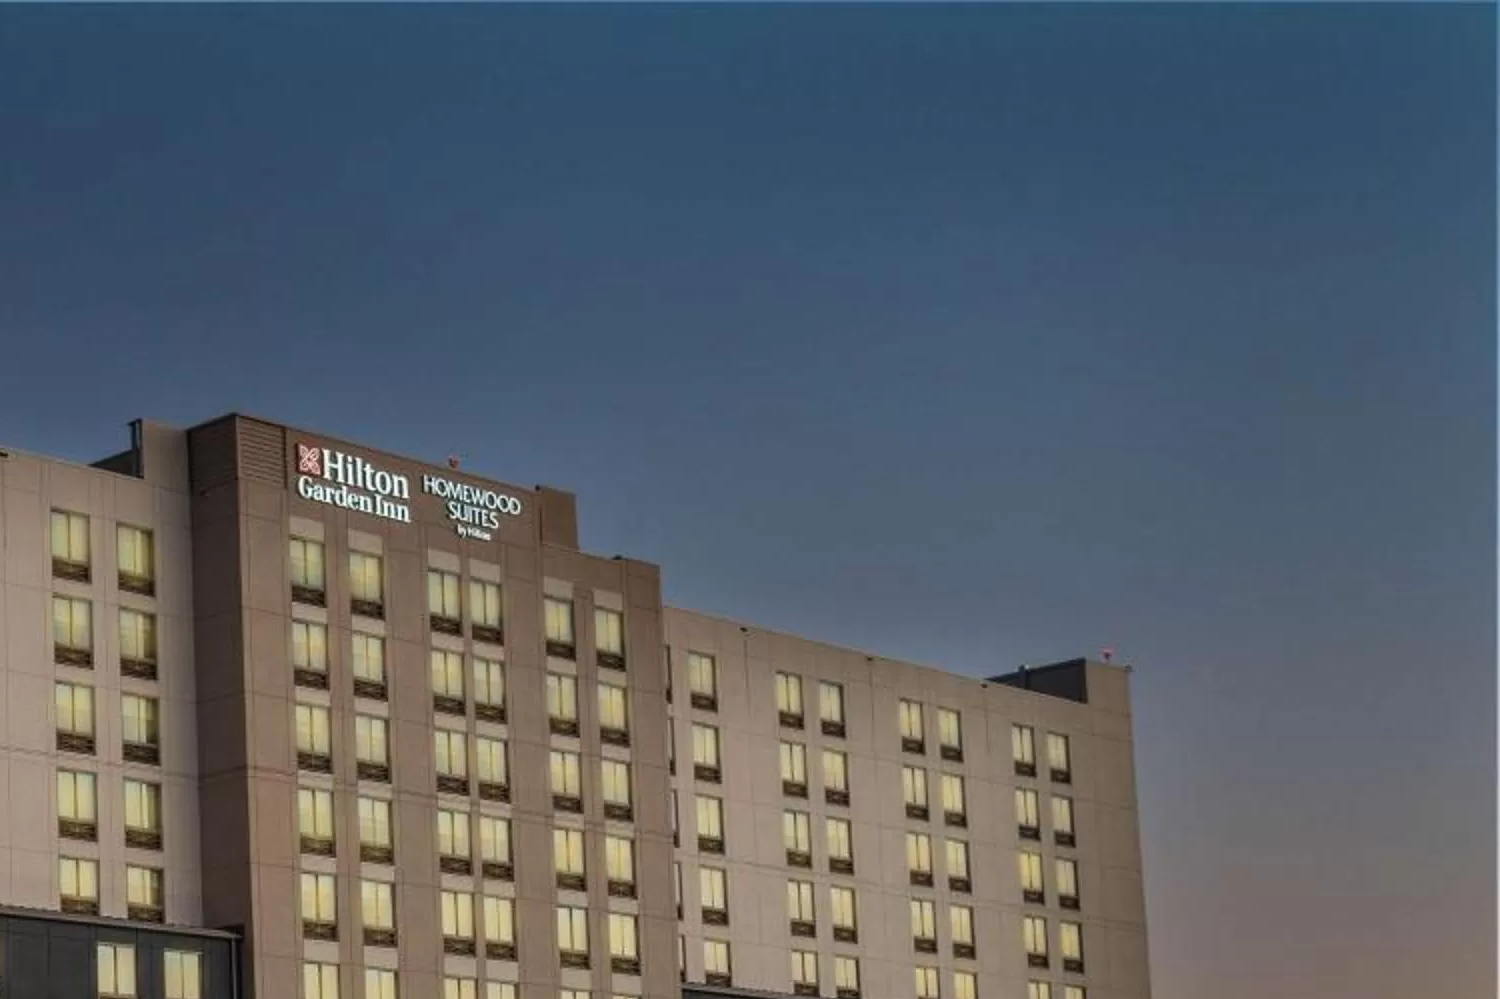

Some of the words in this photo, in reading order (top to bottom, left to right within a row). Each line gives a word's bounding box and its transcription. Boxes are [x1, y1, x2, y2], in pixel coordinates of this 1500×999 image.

[321, 448, 410, 499] Hilton
[423, 474, 521, 515] HOMEWOOD
[298, 475, 373, 513] Garden
[375, 493, 411, 523] Inn
[449, 502, 499, 529] SUITES
